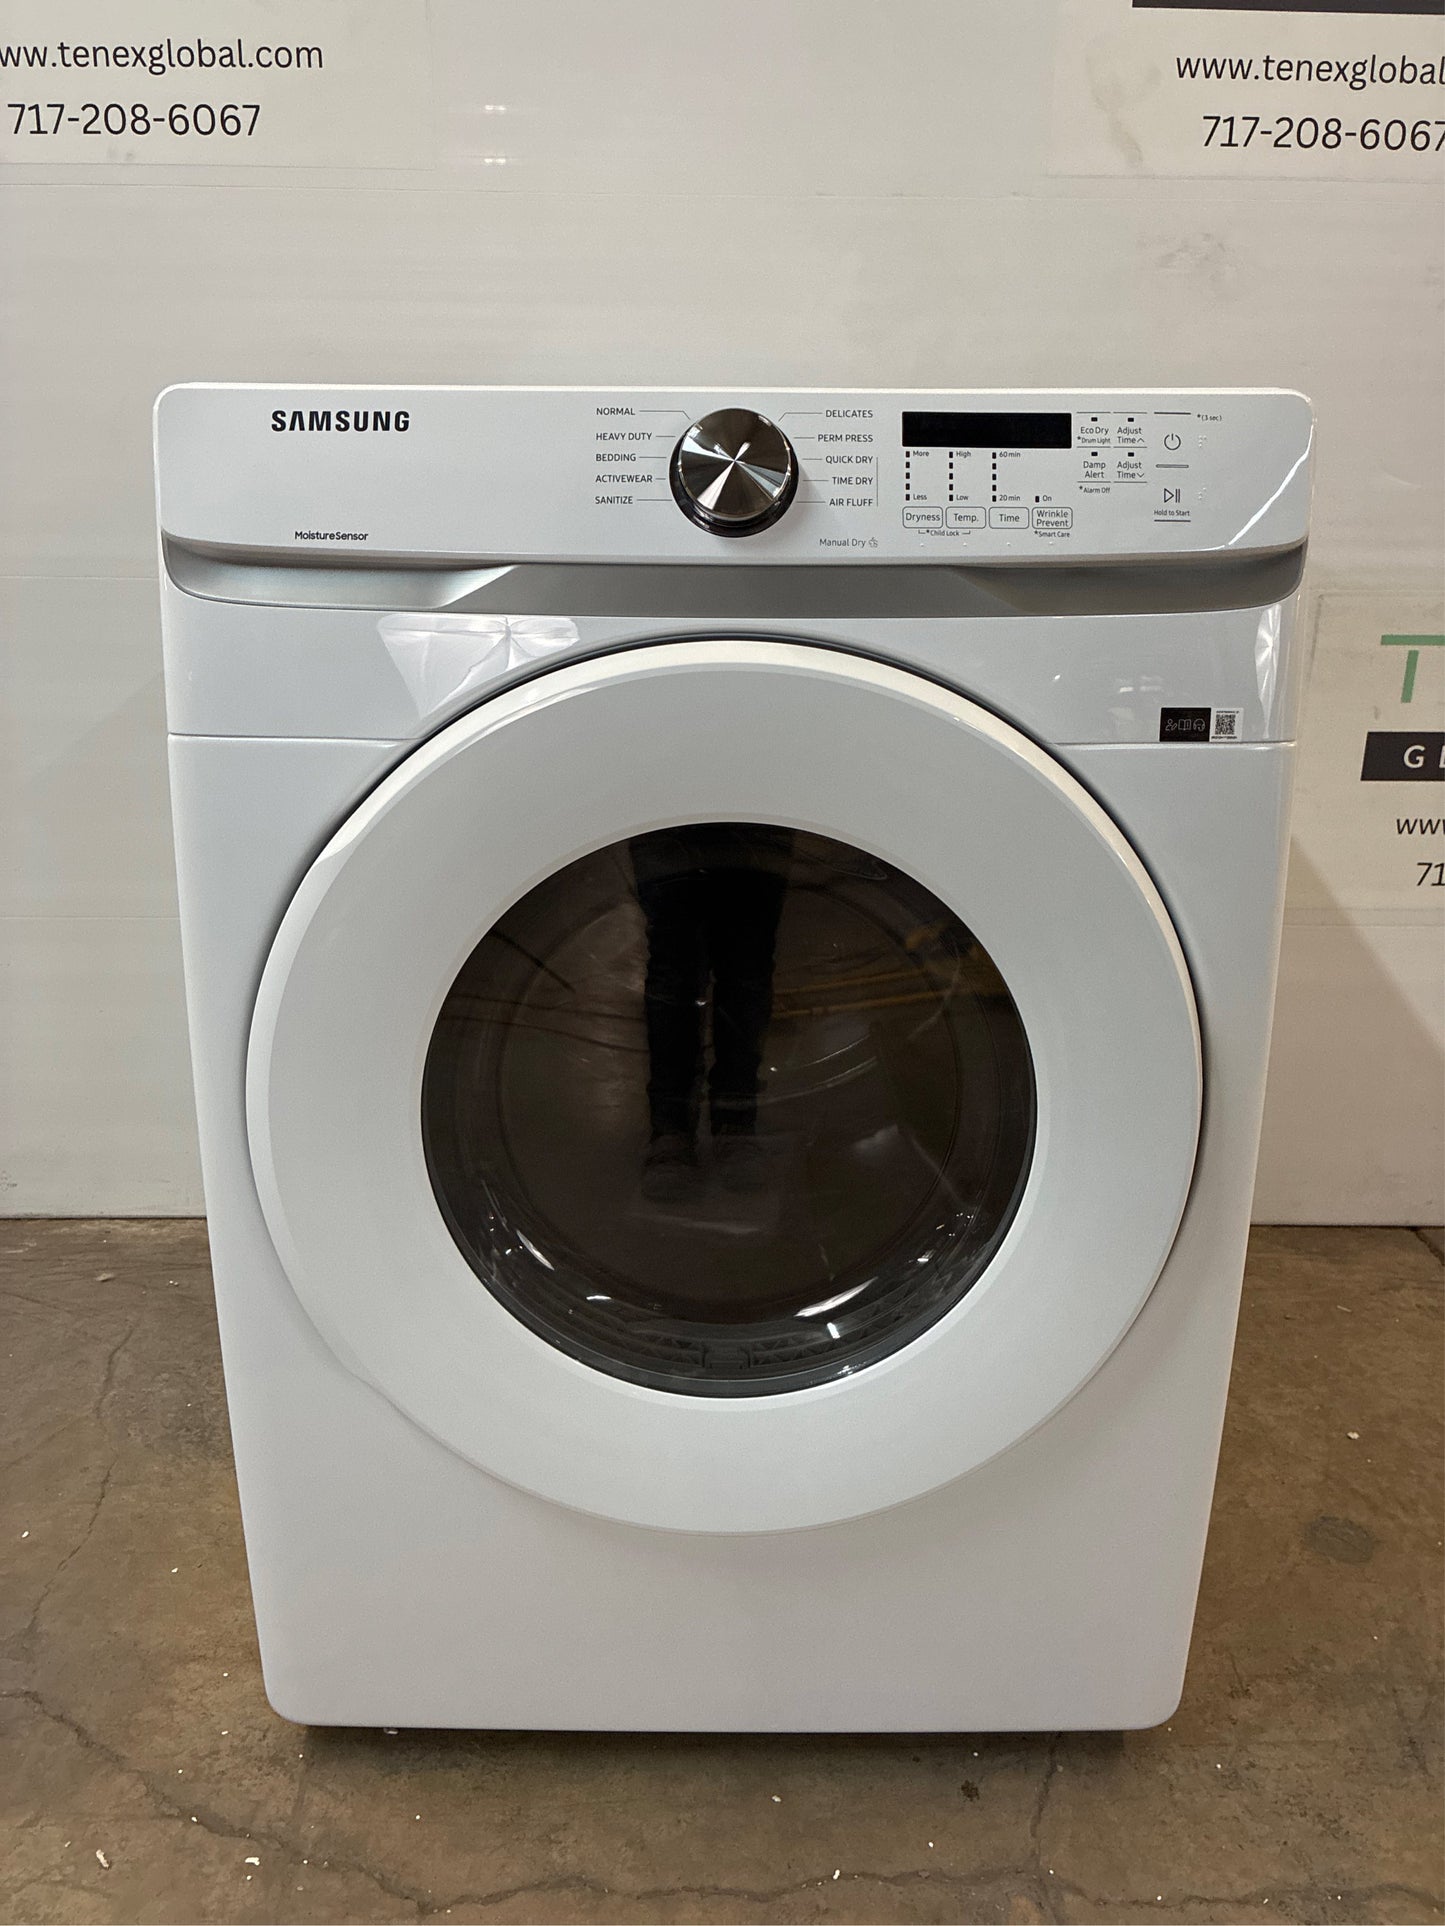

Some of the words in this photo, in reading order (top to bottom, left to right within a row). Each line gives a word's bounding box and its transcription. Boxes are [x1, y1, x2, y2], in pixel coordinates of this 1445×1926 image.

[0, 38, 323, 75] ww.tenexglobal.com
[8, 103, 260, 136] 717-208-6067
[596, 407, 635, 416] NORMAL
[825, 409, 873, 418] DELICATES
[271, 410, 410, 432] SAMSUNG
[1095, 427, 1109, 435] Dry
[1117, 427, 1142, 436] Adjust
[596, 433, 626, 441] HEAVY
[628, 432, 652, 441] DUTY
[818, 434, 843, 442] PERM
[845, 434, 873, 442] PRESS
[1117, 436, 1136, 444] Time
[595, 453, 637, 462] BEDDING
[825, 455, 853, 464] QUICK
[855, 456, 873, 464] DRY
[1083, 461, 1106, 470] Damp
[1117, 461, 1142, 470] Adjust
[595, 474, 653, 483] ACTIVEWEAR
[1085, 470, 1105, 479] Alert
[1117, 471, 1136, 479] Time
[832, 477, 853, 485] TIME
[855, 477, 873, 486] DRY
[595, 496, 633, 505] SANITIZE
[829, 498, 844, 507] AIR
[846, 498, 873, 507] FLUFF
[905, 512, 941, 522] Dryness
[953, 513, 979, 523] Temp.
[999, 513, 1020, 522] Time
[1036, 510, 1069, 518] Wrinkle
[1036, 518, 1069, 527] Prevent
[819, 538, 850, 547] Manual
[851, 539, 866, 548] Dry
[1396, 818, 1445, 835] ww
